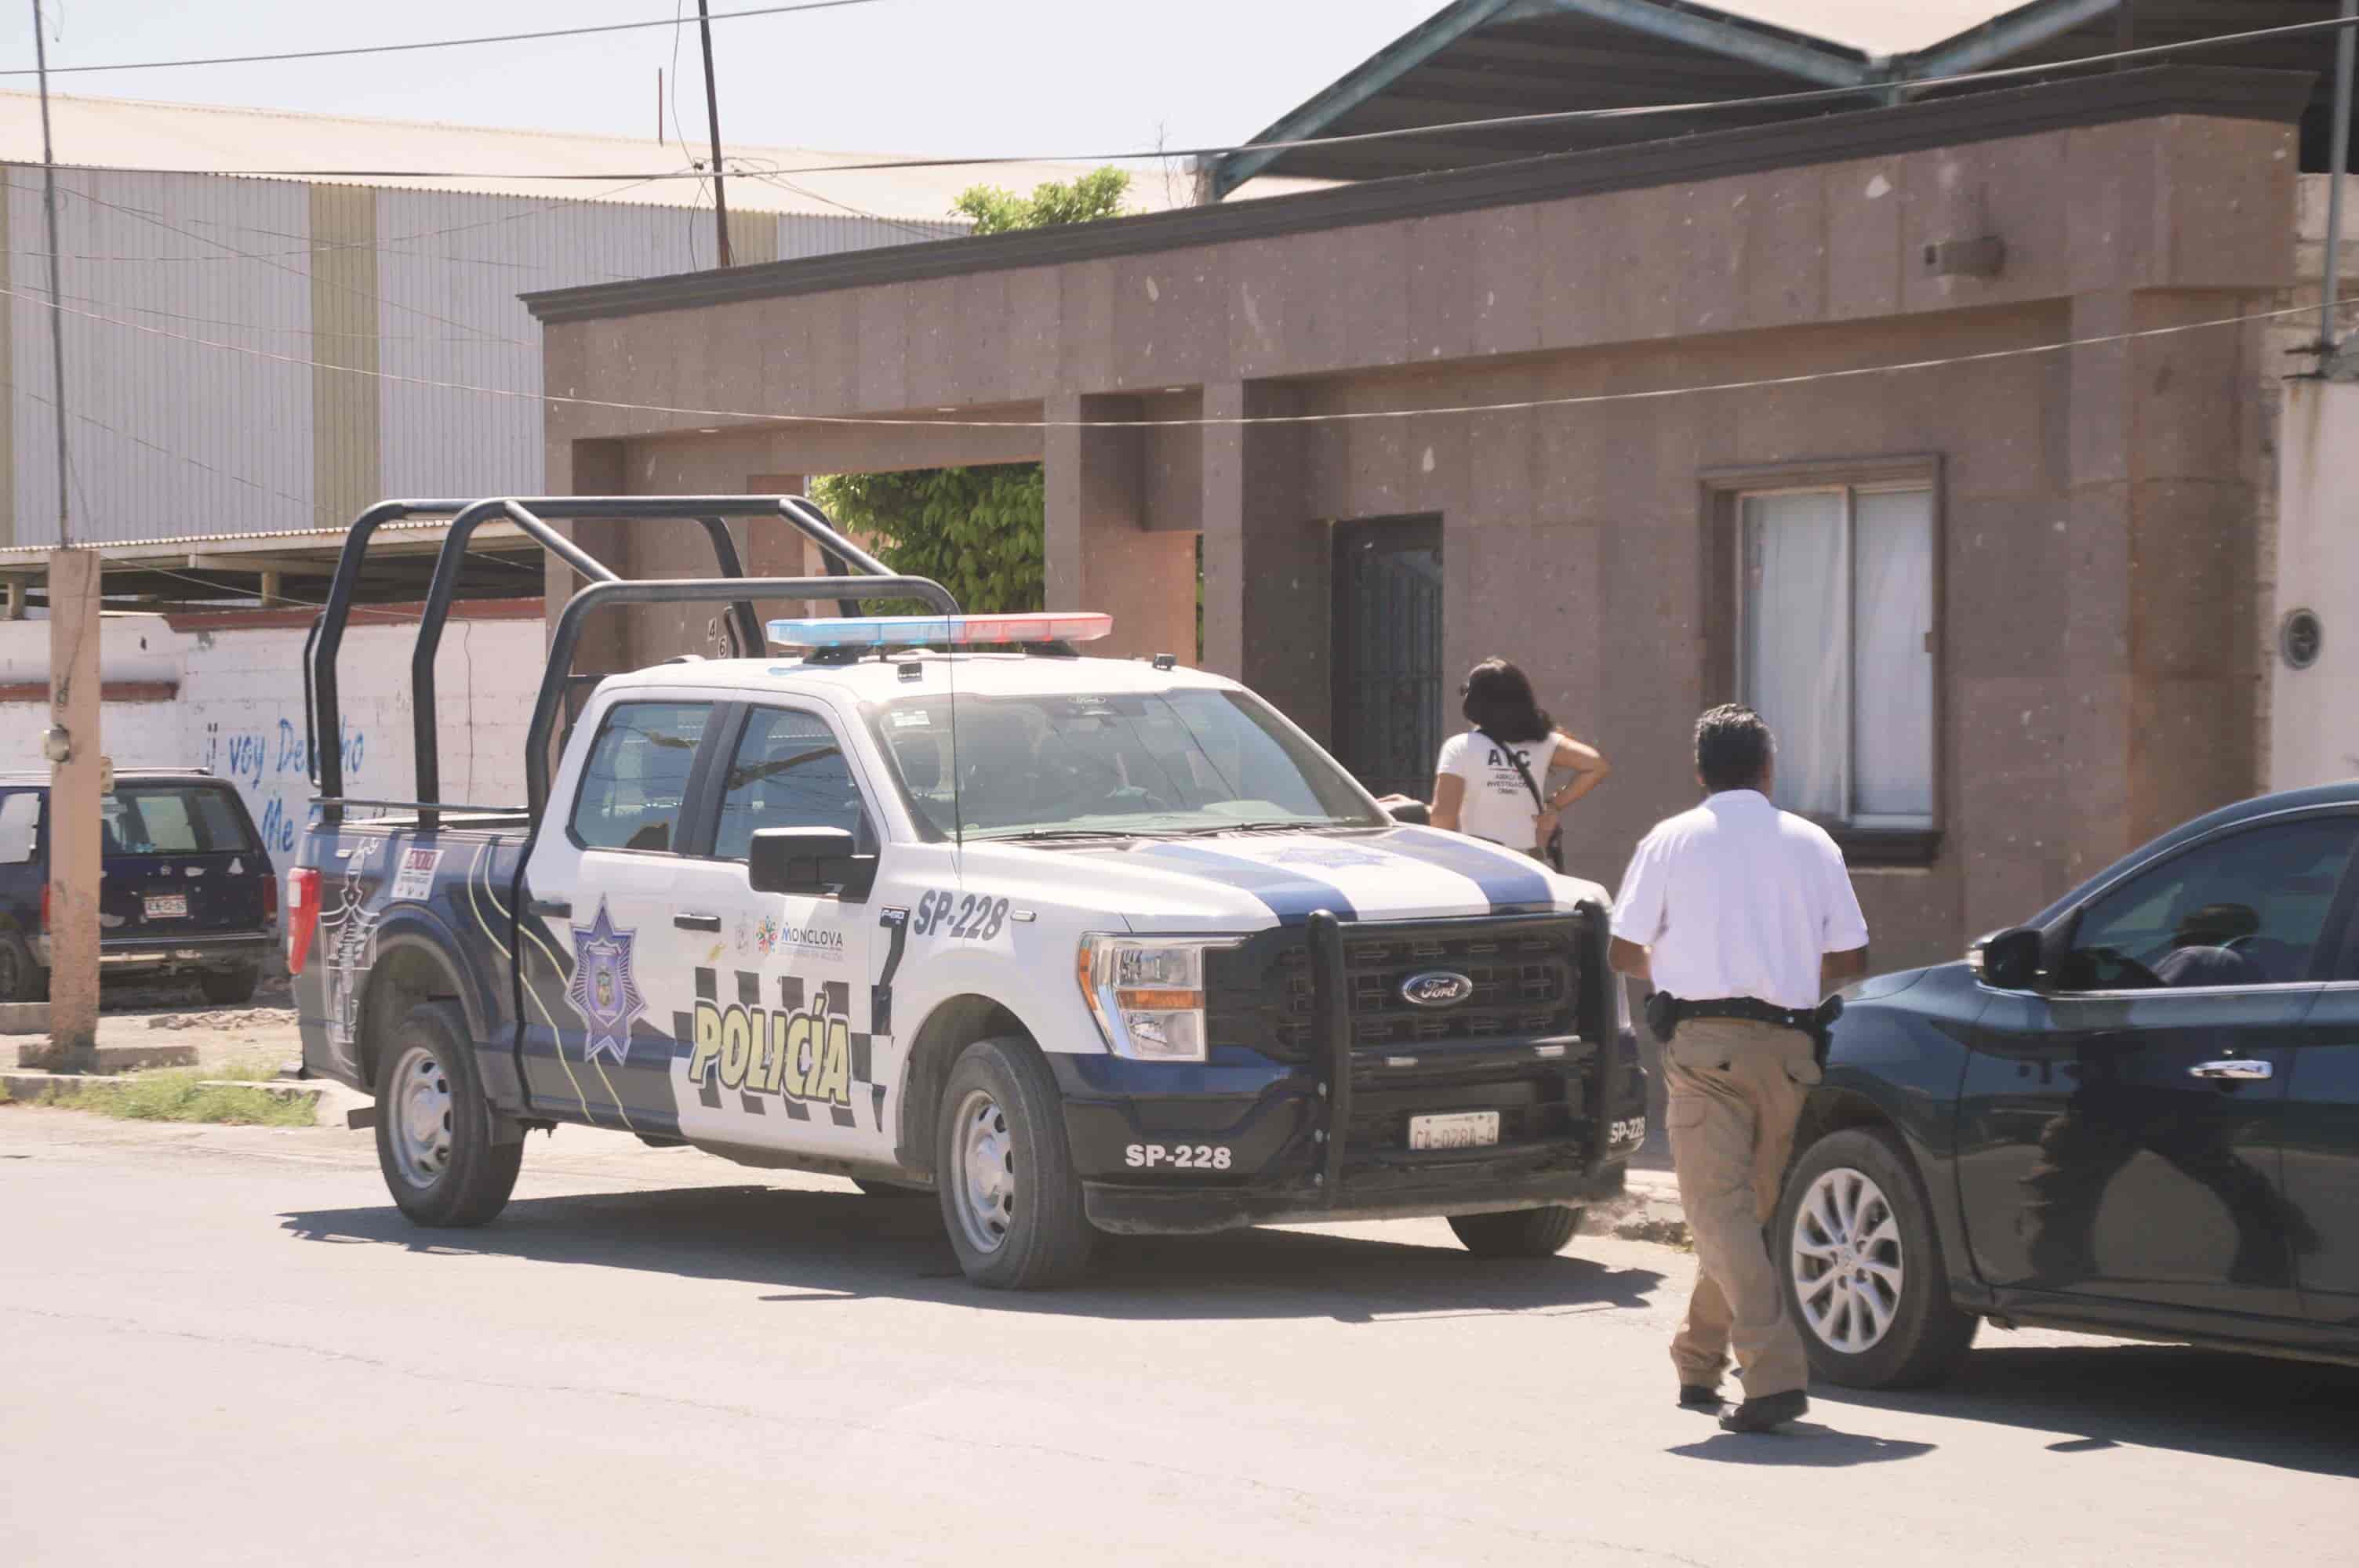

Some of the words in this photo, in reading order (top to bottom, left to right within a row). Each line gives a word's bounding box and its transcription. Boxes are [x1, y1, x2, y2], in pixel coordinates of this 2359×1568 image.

[914, 889, 1009, 941] SP-228
[781, 924, 844, 947] MONCLOVA
[689, 993, 850, 1107] POLICÍA
[1125, 1144, 1232, 1170] SP-228
